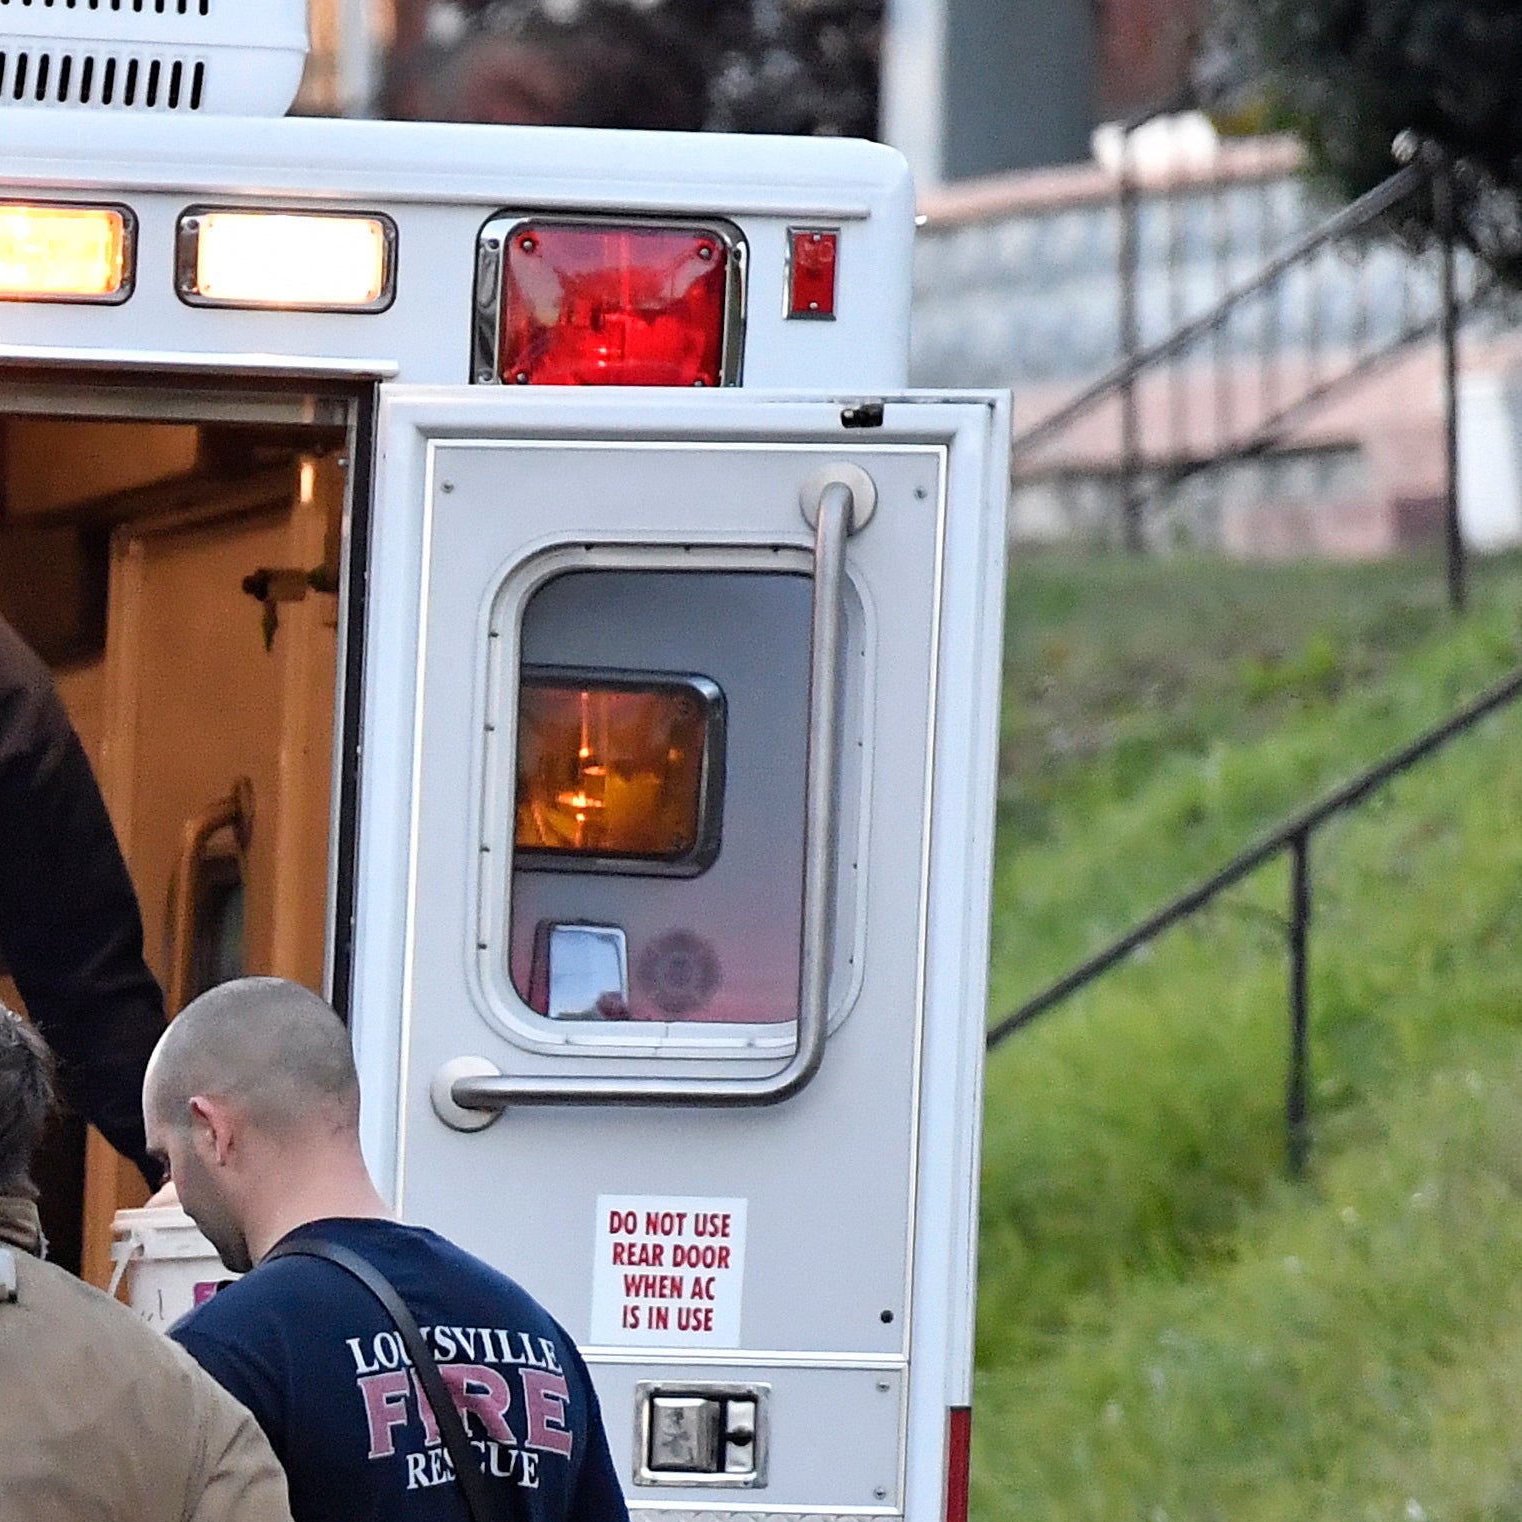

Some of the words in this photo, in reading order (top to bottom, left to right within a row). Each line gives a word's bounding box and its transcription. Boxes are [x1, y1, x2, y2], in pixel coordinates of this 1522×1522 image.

[609, 1210, 638, 1235] DO
[645, 1212, 687, 1237] NOT
[694, 1213, 732, 1238] USE
[612, 1242, 665, 1267] REAR
[672, 1244, 731, 1269] DOOR
[623, 1274, 684, 1299] WHEN
[690, 1276, 716, 1301] AC
[622, 1305, 641, 1329] IS
[647, 1306, 669, 1330] IN
[677, 1307, 715, 1332] USE
